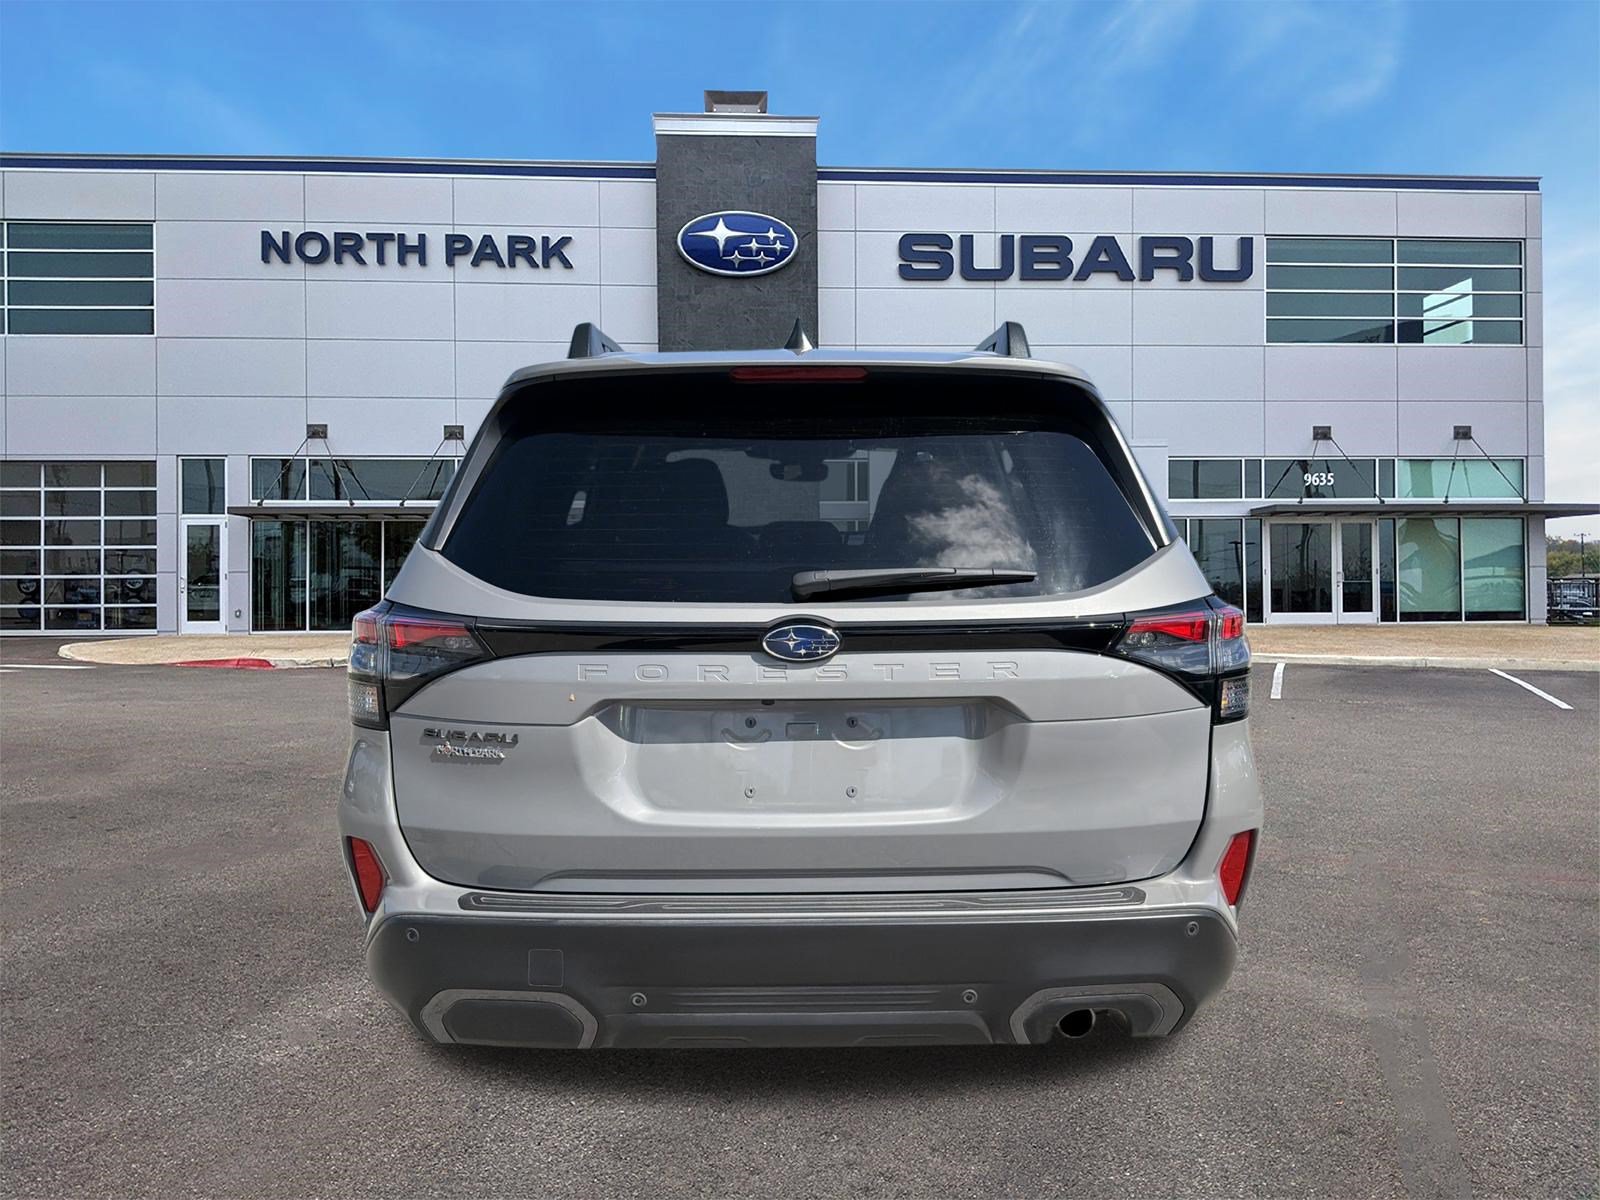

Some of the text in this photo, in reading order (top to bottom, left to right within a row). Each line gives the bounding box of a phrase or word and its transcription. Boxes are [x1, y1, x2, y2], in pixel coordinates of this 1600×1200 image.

[260, 230, 573, 269] NORTH PARK
[898, 232, 1254, 283] SUBARU
[1304, 473, 1334, 486] 9635
[577, 660, 1022, 682] FORESTER
[423, 728, 518, 744] SUBARU
